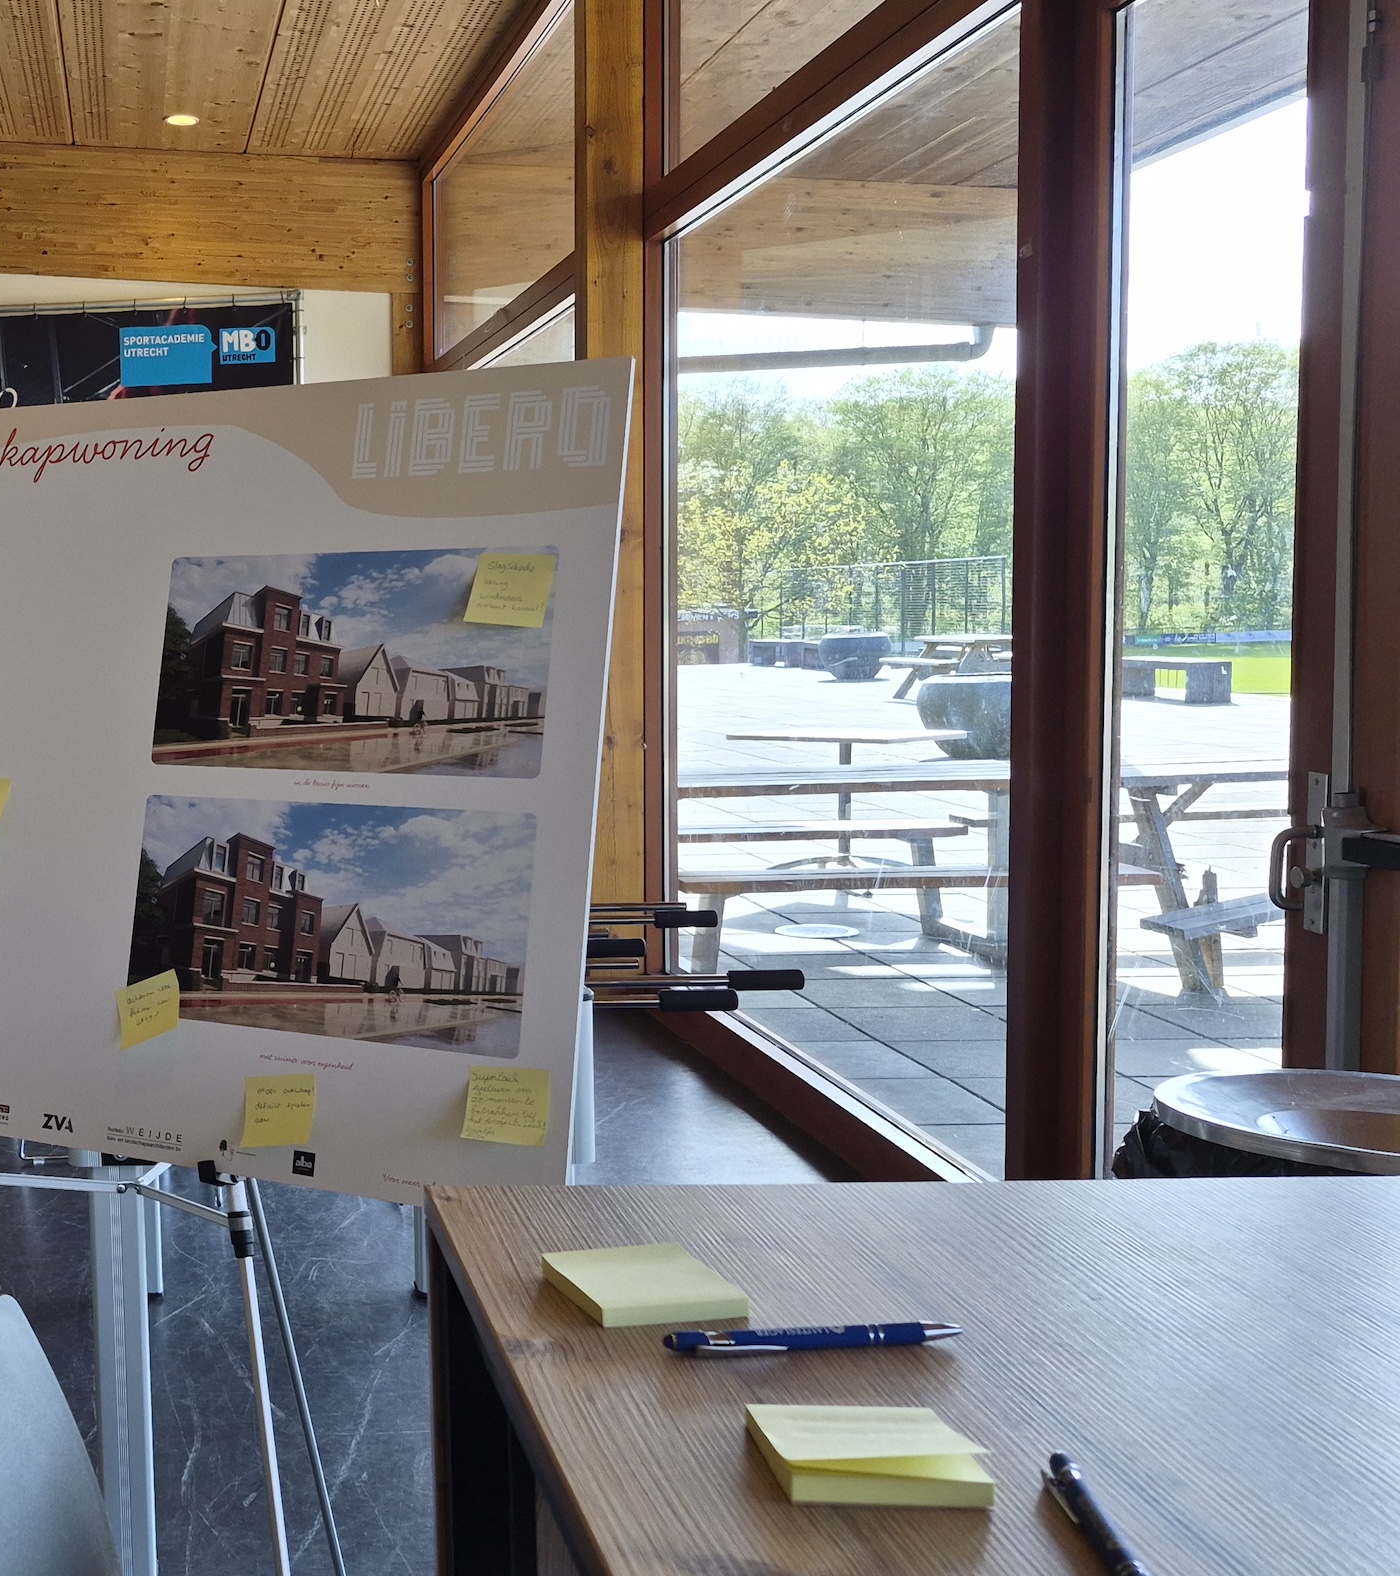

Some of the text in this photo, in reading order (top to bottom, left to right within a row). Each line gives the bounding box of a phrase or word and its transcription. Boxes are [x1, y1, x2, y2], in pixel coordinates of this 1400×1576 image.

[123, 333, 205, 346] SPORTACADEMIE
[222, 330, 271, 353] MBO
[123, 347, 169, 358] UTRECHT
[222, 353, 256, 362] UTRECHT
[312, 779, 330, 787] basis
[331, 779, 344, 791] fijn
[274, 1055, 298, 1063] ruimte
[317, 1061, 354, 1071] eigenheid
[42, 1113, 74, 1134] ZVA
[107, 1126, 183, 1143] bureau WEIJDE
[124, 1138, 175, 1151] landschapsarchitecten
[295, 1155, 313, 1168] alba
[382, 1173, 400, 1184] Voor
[401, 1180, 421, 1188] meer
